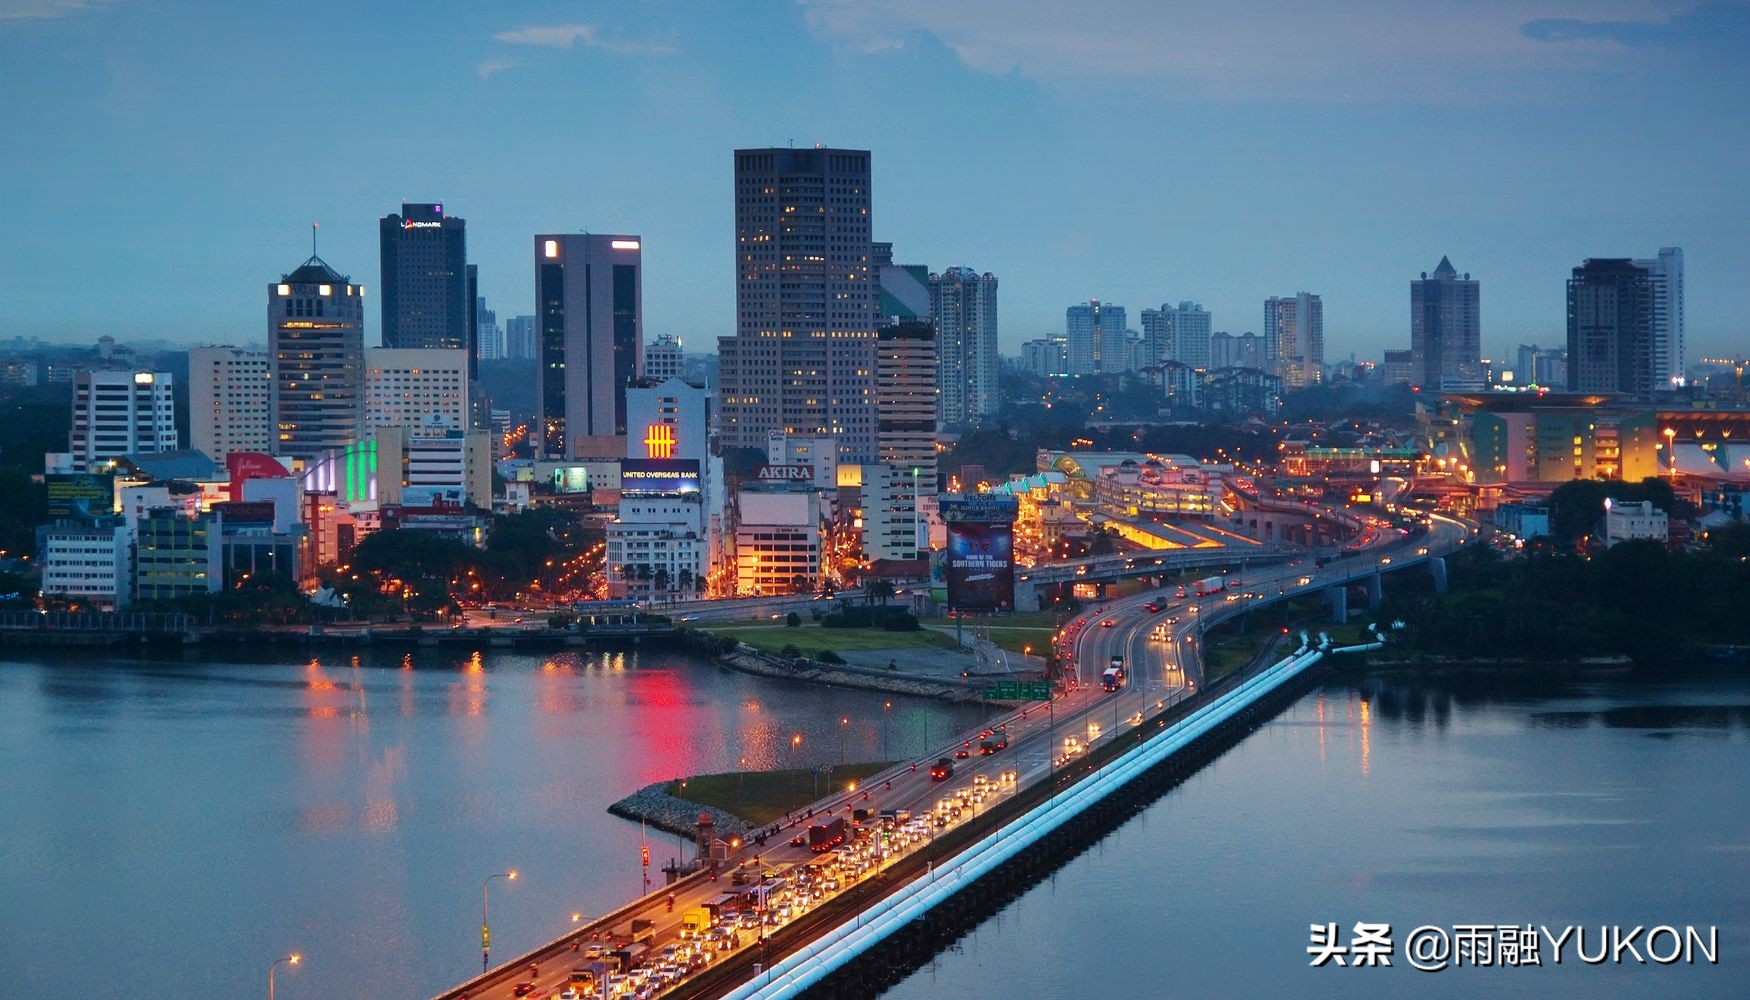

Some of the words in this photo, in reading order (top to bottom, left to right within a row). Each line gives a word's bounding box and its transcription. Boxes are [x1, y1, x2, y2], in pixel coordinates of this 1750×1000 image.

[401, 219, 441, 229] LANDMARK
[759, 466, 811, 479] AKIRA
[952, 560, 985, 568] SOUTHERN
[986, 560, 1008, 568] TIGERS
